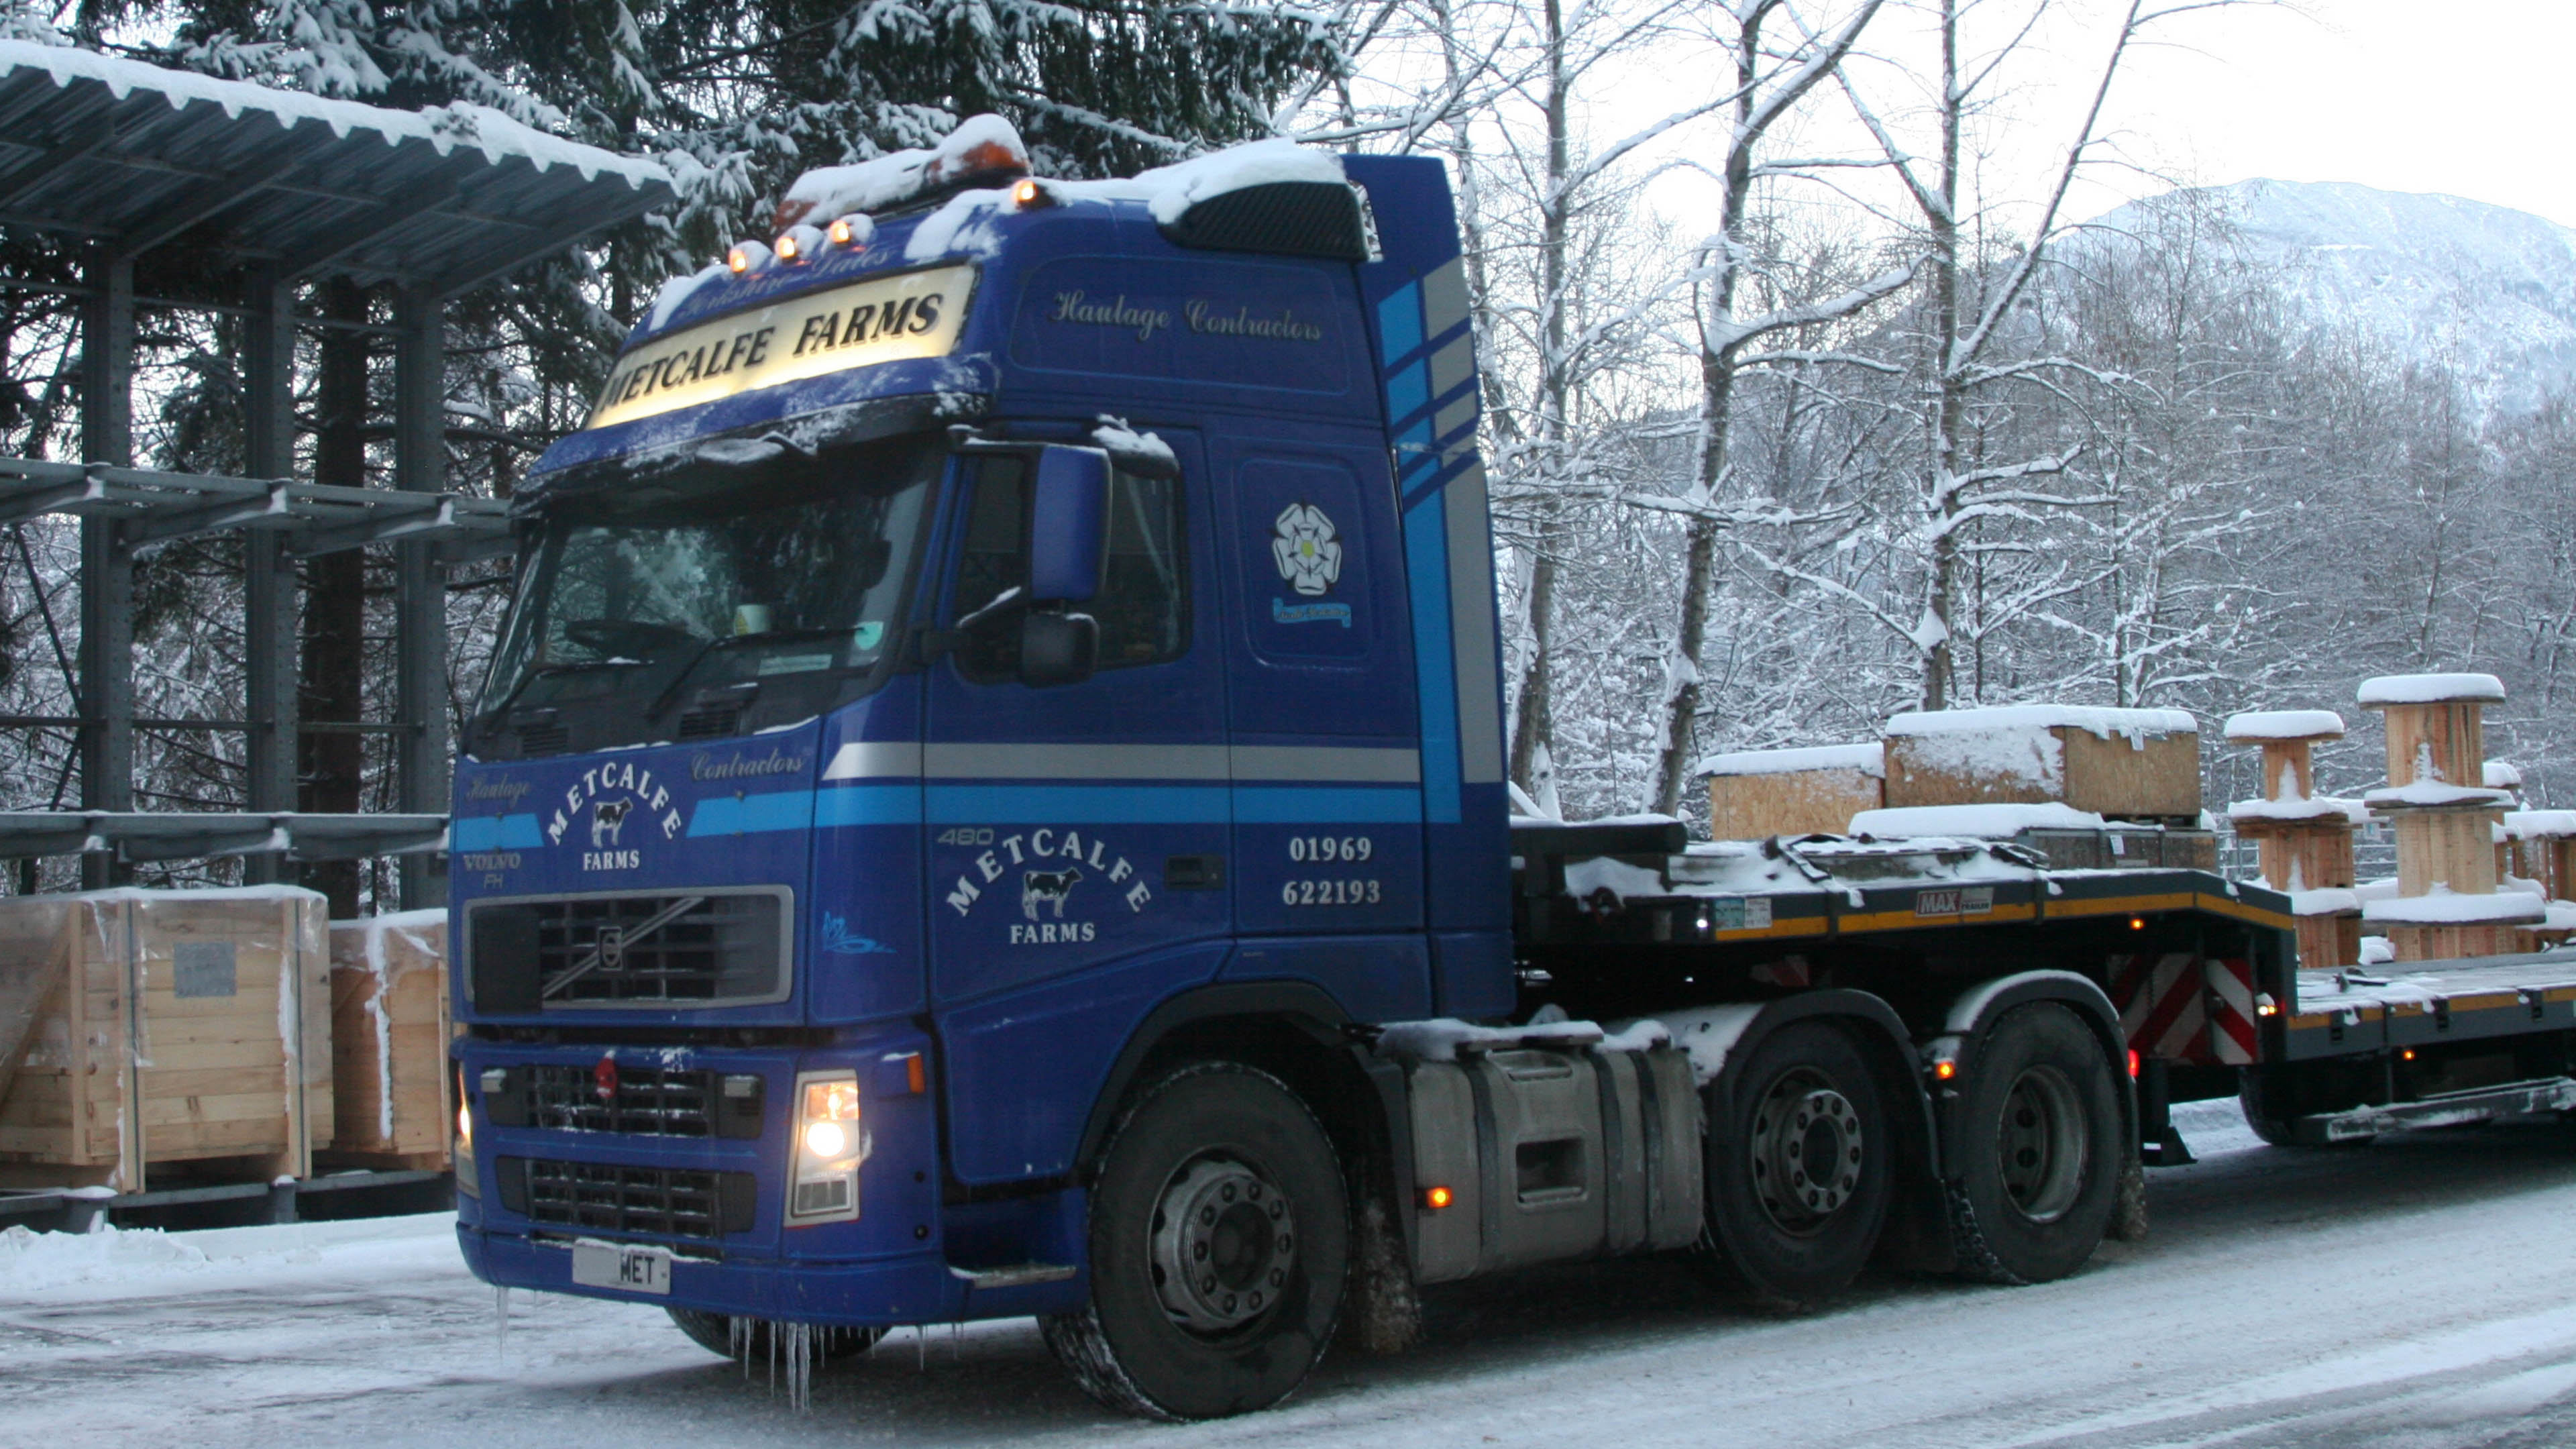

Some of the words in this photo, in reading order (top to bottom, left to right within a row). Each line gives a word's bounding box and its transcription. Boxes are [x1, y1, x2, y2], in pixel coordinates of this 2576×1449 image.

[1049, 291, 1169, 341] Haulage
[1185, 299, 1322, 341] Contractors
[599, 327, 775, 412] METCALFE
[793, 292, 945, 357] FARMS
[690, 747, 804, 782] Contractors
[547, 762, 682, 846] METCALFE
[938, 828, 994, 846] 480
[1289, 837, 1373, 862] 01969
[462, 852, 521, 871] VOLVO
[583, 849, 640, 871] FARMS
[946, 828, 1152, 917] METCALFE
[484, 873, 504, 890] FH
[1283, 879, 1381, 906] 622193
[1921, 891, 1958, 914] MAX
[1010, 922, 1095, 945] FARMS
[620, 1253, 655, 1285] MET
